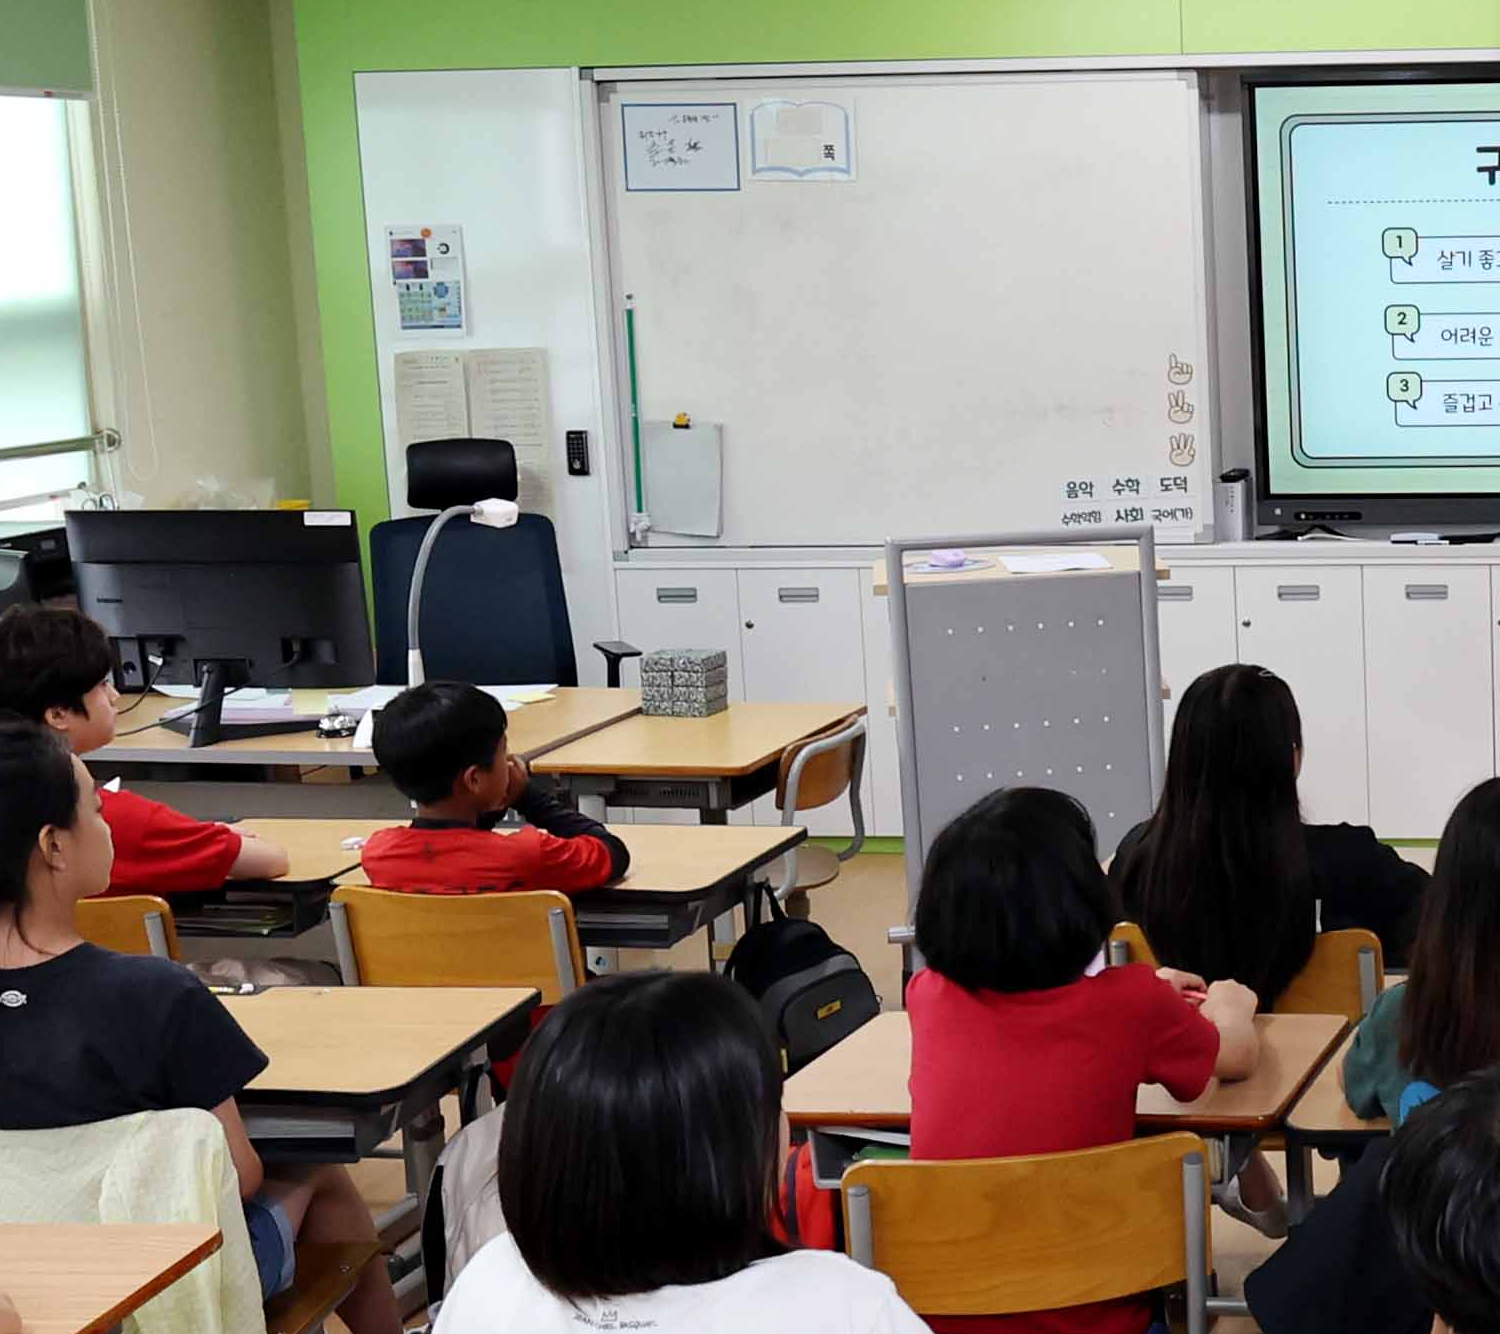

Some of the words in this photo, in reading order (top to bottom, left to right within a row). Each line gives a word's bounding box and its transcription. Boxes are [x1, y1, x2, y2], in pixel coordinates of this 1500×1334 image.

[823, 144, 835, 160] 쪽
[1396, 235, 1403, 248] 1
[1437, 249, 1473, 270] 살기
[1397, 312, 1407, 325] 2
[1441, 327, 1494, 347] 어려운
[1399, 379, 1409, 392] 3
[1443, 393, 1492, 414] 즐겁고
[1067, 481, 1094, 498] 음악
[1112, 477, 1140, 495] 수학
[1160, 476, 1187, 493] 도덕
[1115, 507, 1144, 522] 사회
[1151, 507, 1193, 522] 국어(가)
